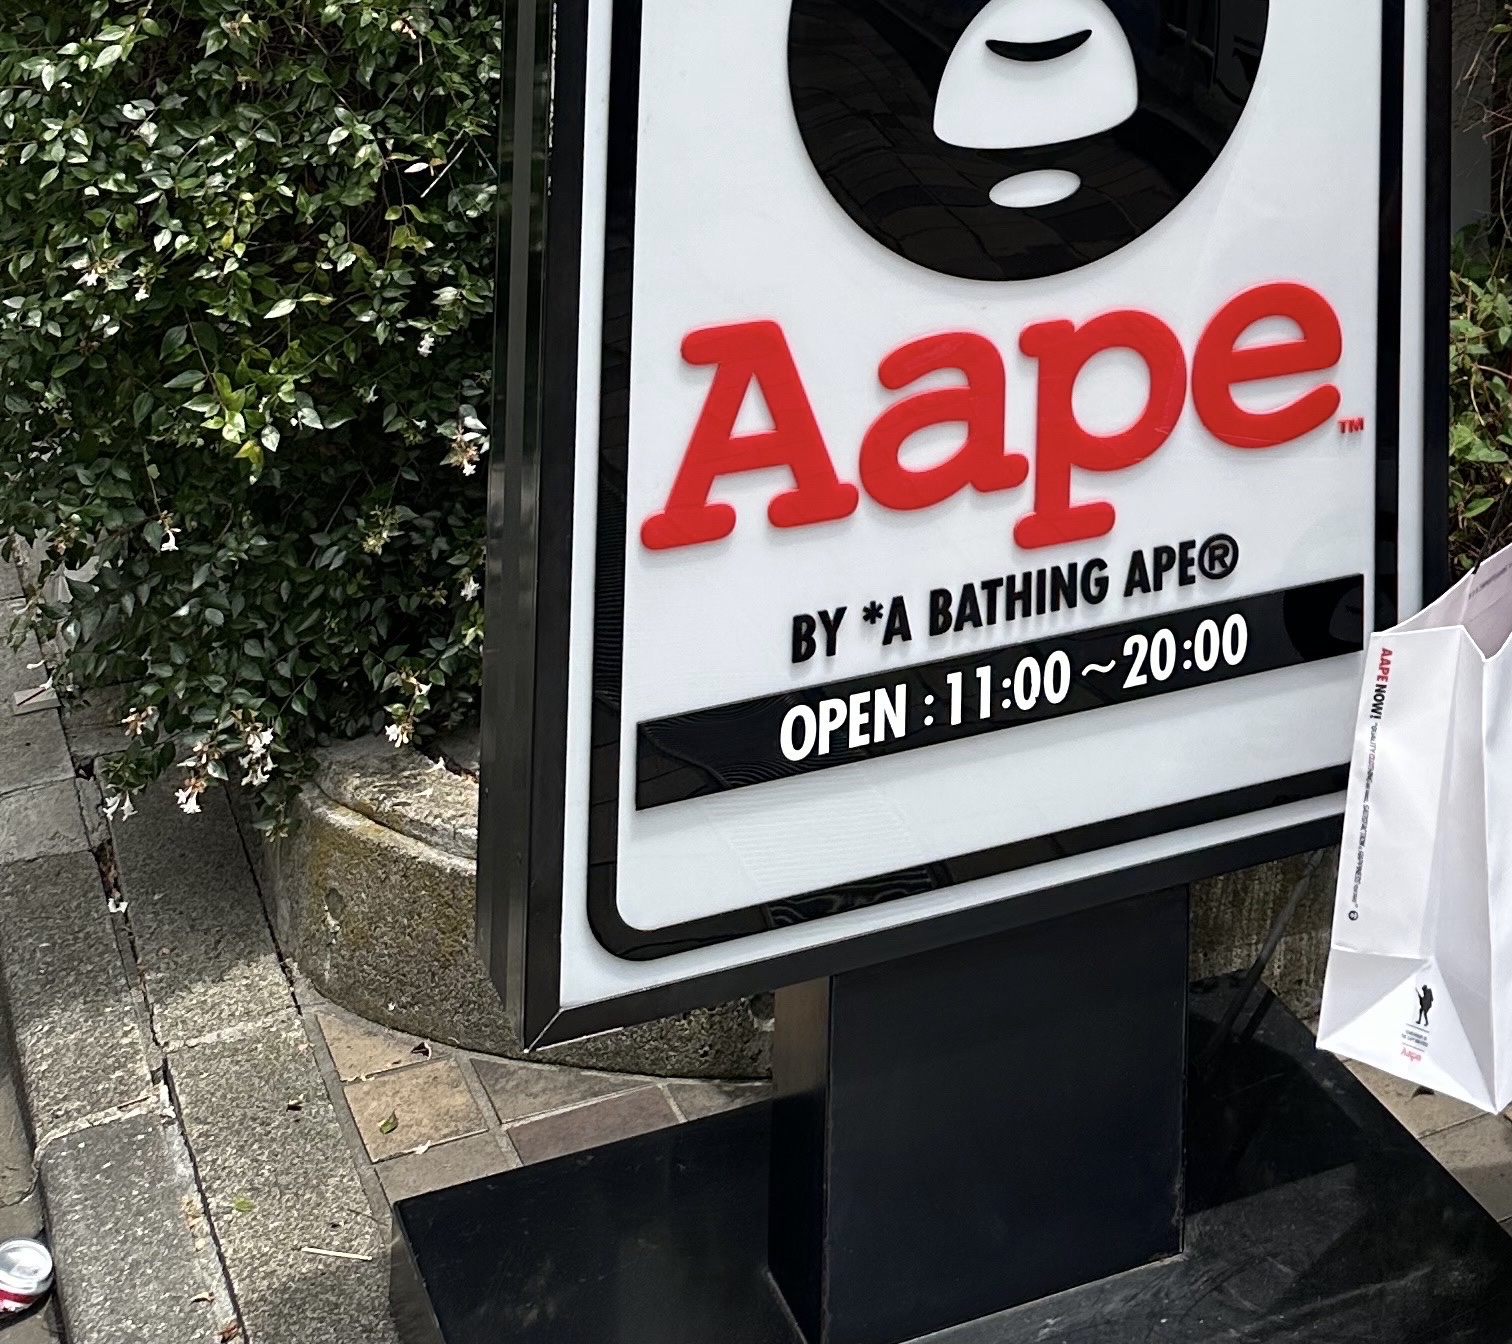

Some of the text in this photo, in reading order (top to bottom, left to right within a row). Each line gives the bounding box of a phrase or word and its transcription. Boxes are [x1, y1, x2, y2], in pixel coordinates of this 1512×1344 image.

[640, 280, 1344, 551] Aape
[791, 606, 848, 664] BY
[928, 557, 1110, 637] BATHING
[1369, 683, 1388, 720] NOW!
[1376, 647, 1393, 683] AAPE
[780, 683, 907, 762] OPEN
